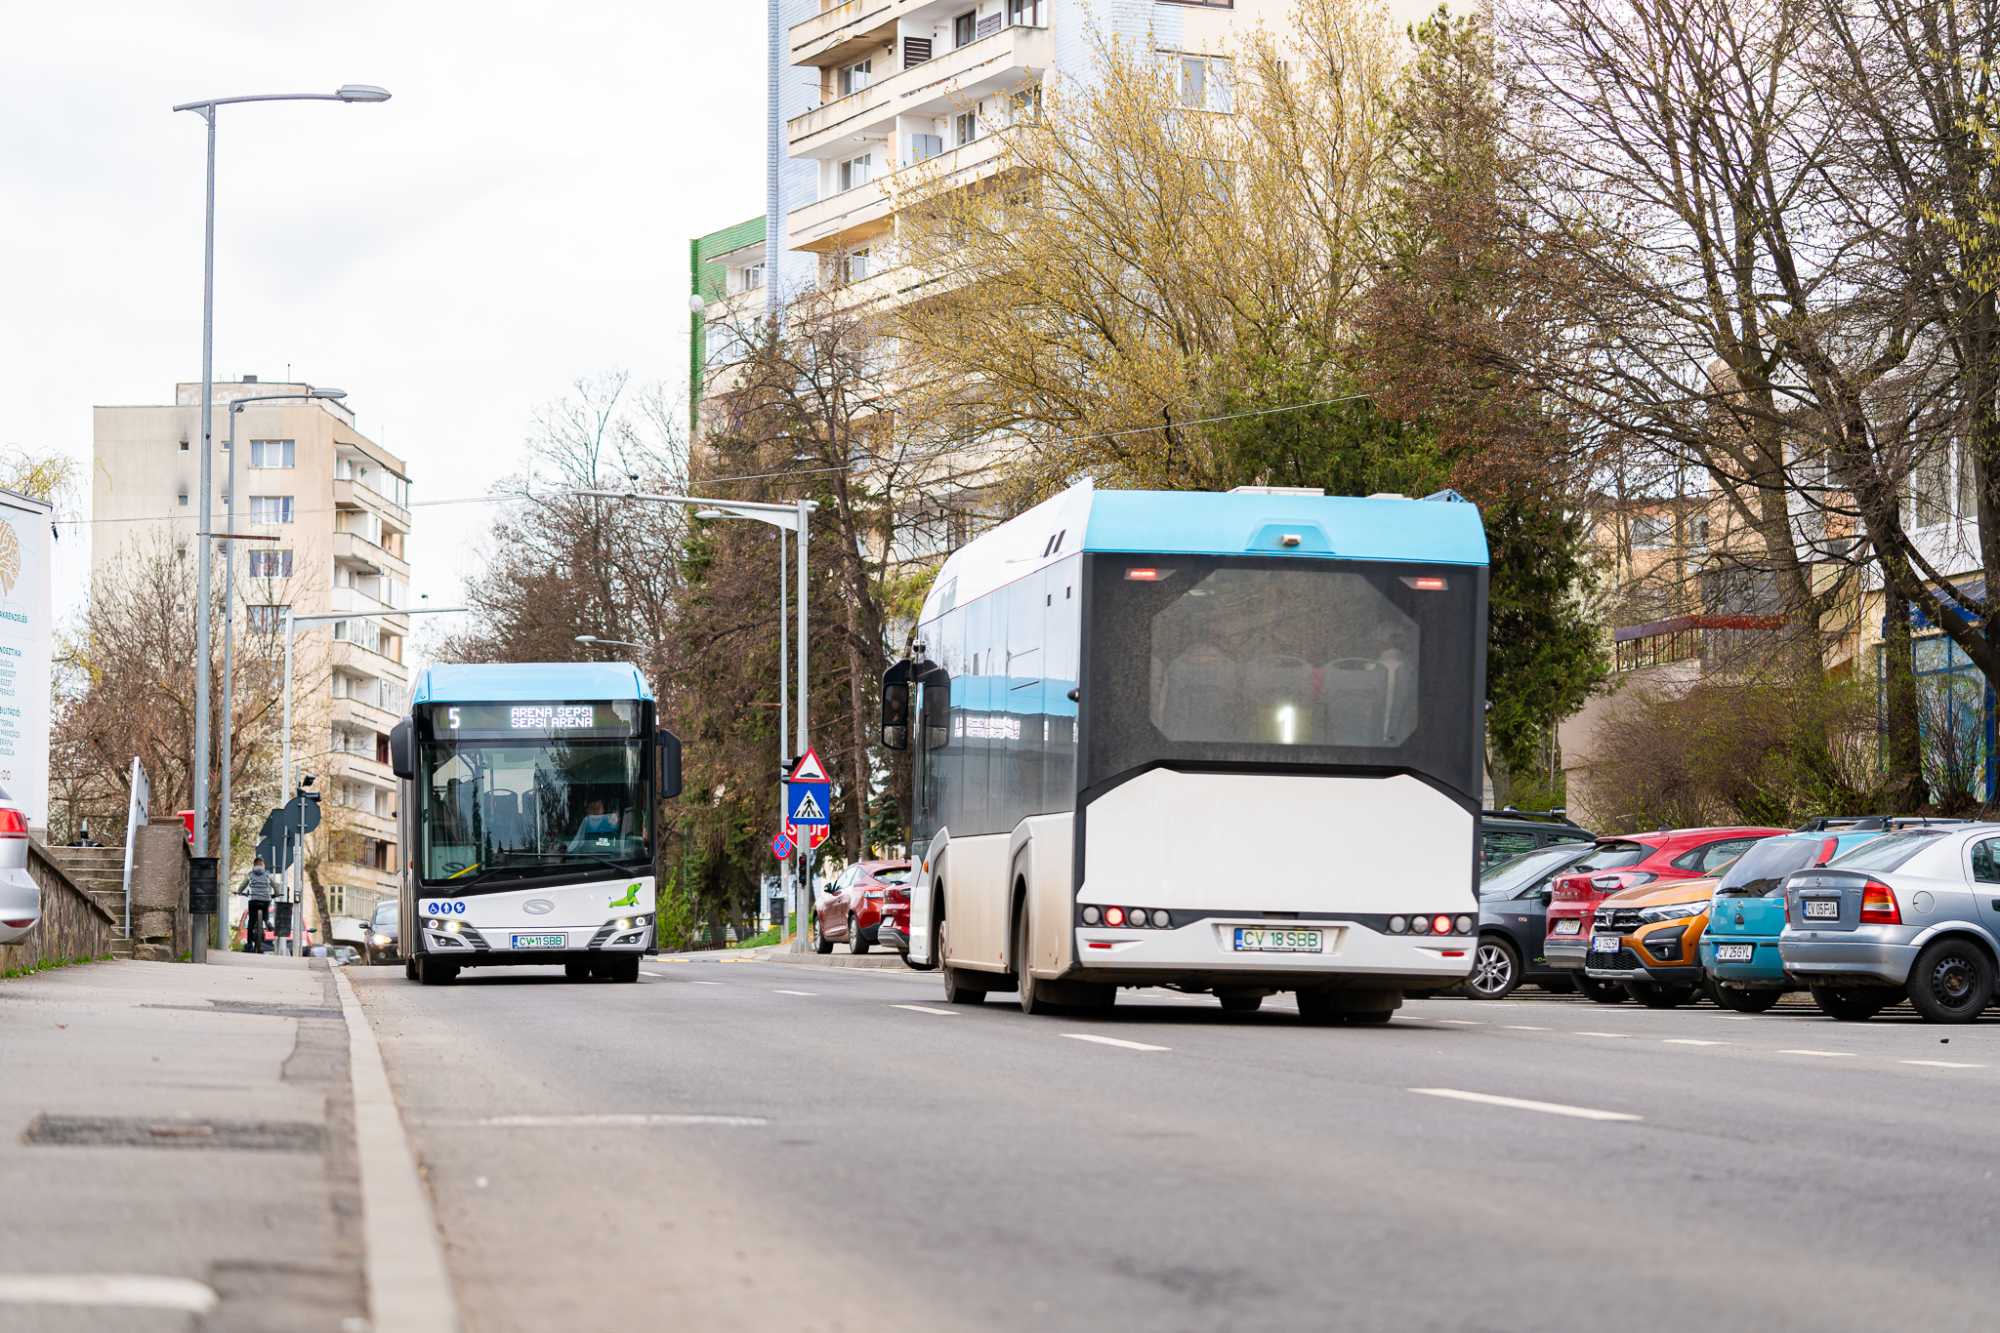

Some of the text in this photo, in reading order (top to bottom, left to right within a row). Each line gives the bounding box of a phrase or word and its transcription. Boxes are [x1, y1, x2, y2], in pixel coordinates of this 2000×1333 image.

[449, 707, 460, 728] 5
[511, 707, 593, 718] ARENA SEPSI
[511, 717, 593, 728] SEPSI ARENA
[543, 936, 562, 946] SBB
[1244, 931, 1318, 947] CV 18 SBB
